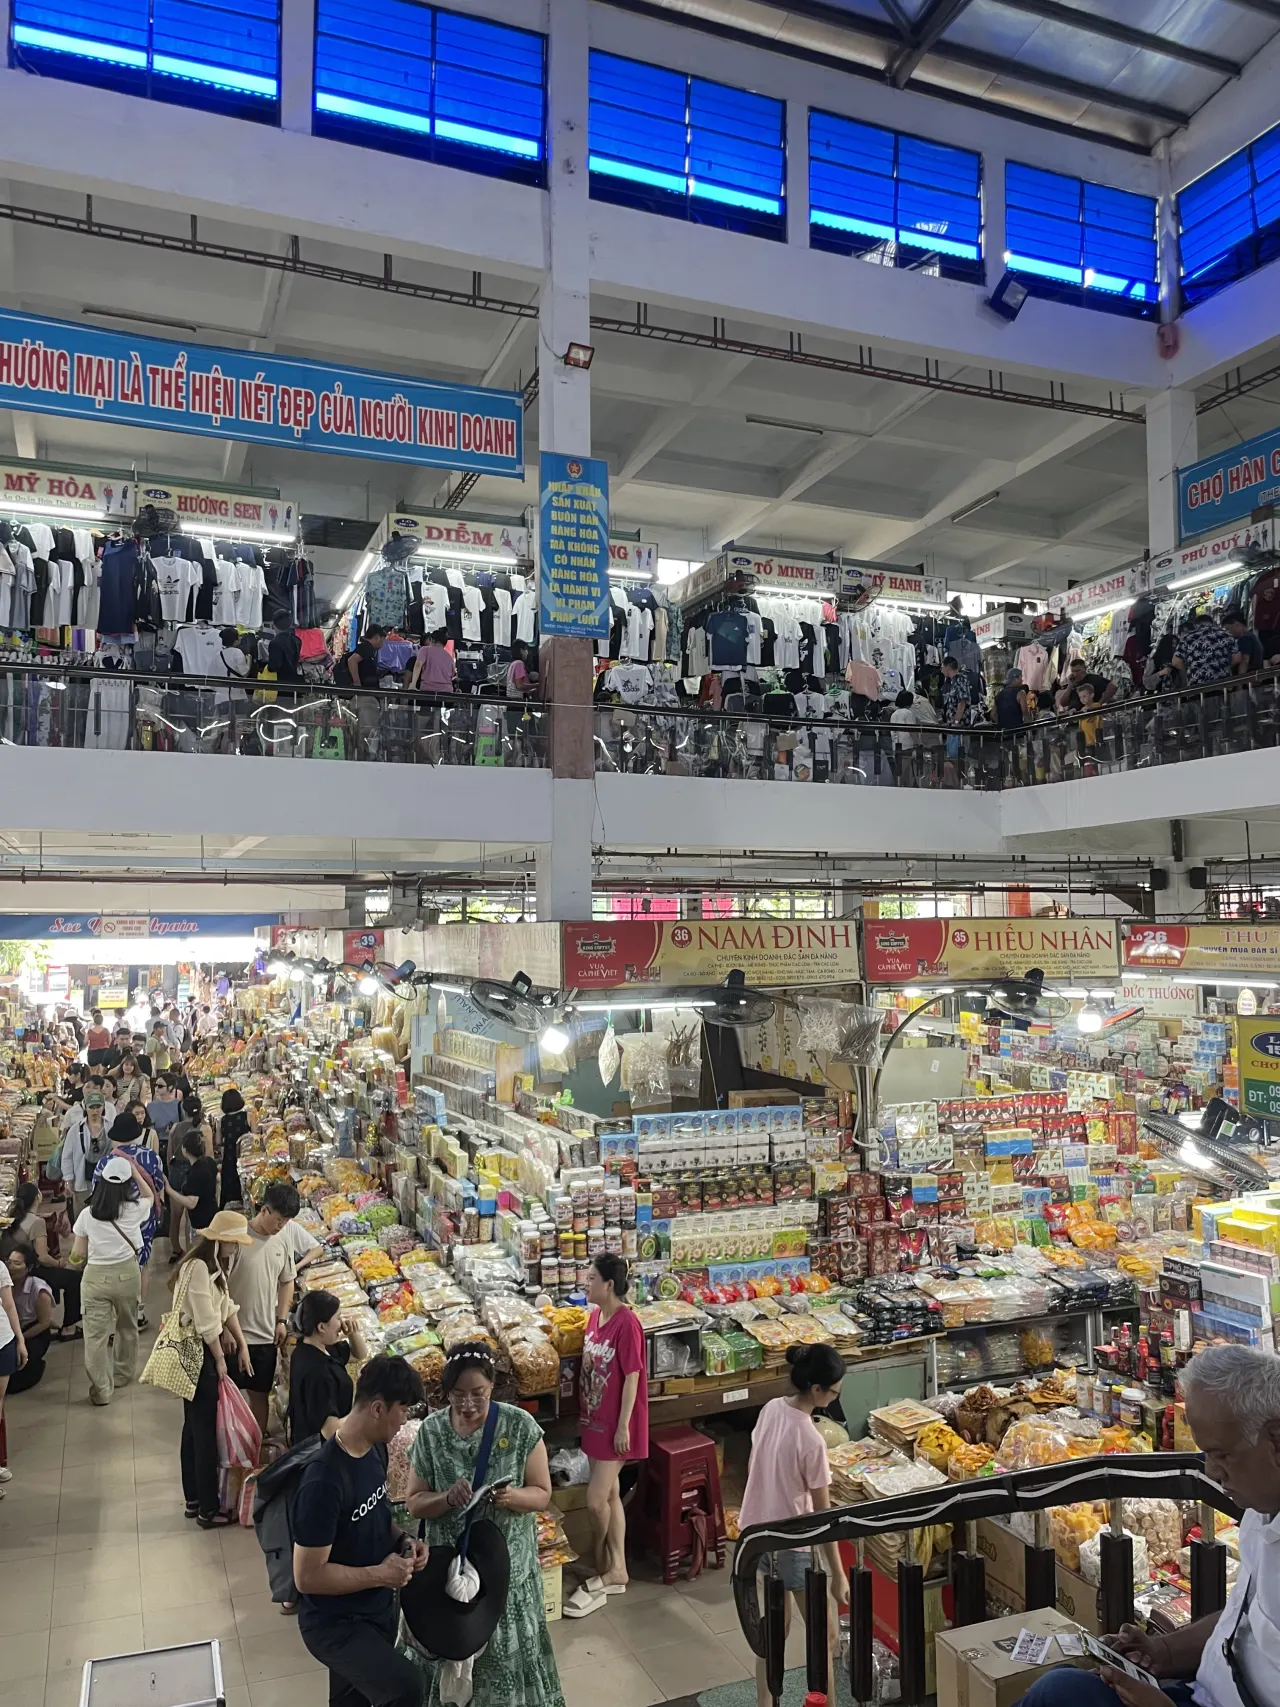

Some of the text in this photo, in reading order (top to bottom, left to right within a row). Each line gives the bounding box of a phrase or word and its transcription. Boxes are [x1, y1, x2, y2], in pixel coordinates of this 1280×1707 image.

[74, 352, 115, 409] MẠI
[118, 351, 145, 406] LÀ
[147, 351, 187, 412] THỂ
[189, 365, 236, 426] HIỆN
[239, 372, 275, 424] NÉT
[278, 384, 315, 438] ĐẸP
[319, 381, 357, 437] CỦA
[360, 393, 413, 444] NGƯỜI
[417, 407, 457, 450] KINH
[460, 413, 516, 458] DOANH
[4, 472, 97, 500] MỸ HÒA
[1188, 468, 1224, 509] CHỢ
[1228, 456, 1266, 494] HÀN
[177, 494, 262, 521] HƯƠNG SEN
[551, 510, 577, 523] BUÔN
[425, 523, 493, 547] DIỄM
[551, 525, 599, 540] HÀNG HÓA
[568, 541, 600, 554] KHÔNG
[1181, 534, 1240, 564] PHÚ QUÝ
[554, 553, 568, 565] CÓ
[551, 567, 599, 583] HÀNG HÓA
[777, 565, 814, 579] MINH
[563, 583, 588, 596] HÀNH
[591, 587, 601, 597] VI
[889, 576, 922, 593] HẠNH
[1088, 576, 1126, 599] HẠNH
[50, 917, 82, 933] See
[361, 935, 375, 946] 39
[675, 929, 689, 942] 36
[698, 924, 852, 954] NAM ĐỊNH
[954, 931, 966, 943] 35
[973, 923, 1113, 951] HIẾU NHÂN
[1131, 931, 1168, 944] LÔ 26
[1221, 928, 1268, 943] THU
[1230, 946, 1249, 954] MUA
[1251, 946, 1267, 954] BÁN
[717, 954, 742, 962] CHUYÊN
[743, 954, 758, 962] KINH
[1123, 984, 1195, 1000] ĐỨC THƯƠNG
[1251, 1060, 1279, 1072] CHỢ
[1249, 1090, 1267, 1104] ĐT:
